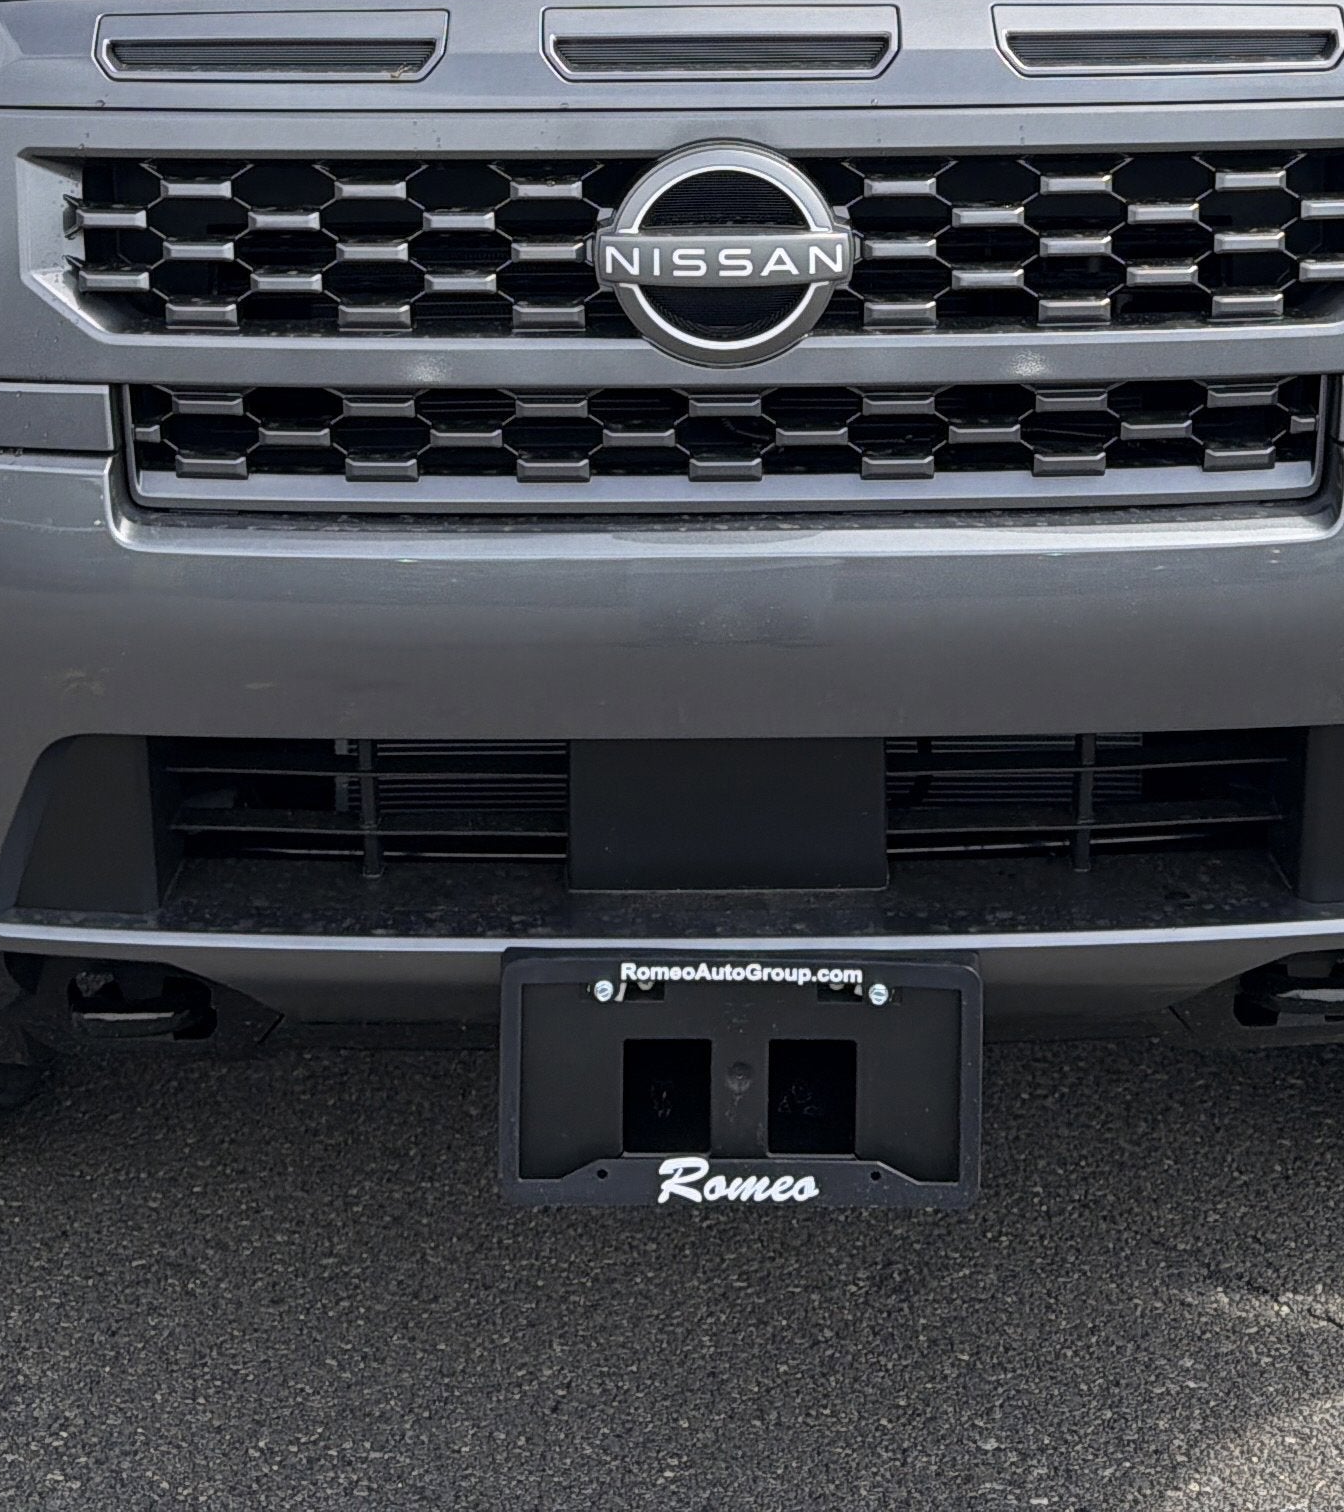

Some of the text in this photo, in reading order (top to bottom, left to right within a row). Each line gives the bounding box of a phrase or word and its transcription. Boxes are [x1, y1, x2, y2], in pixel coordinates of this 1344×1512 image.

[606, 243, 844, 277] NISSAN
[620, 962, 863, 986] RomeoAutoGroup.com
[658, 1156, 820, 1204] Romeo
